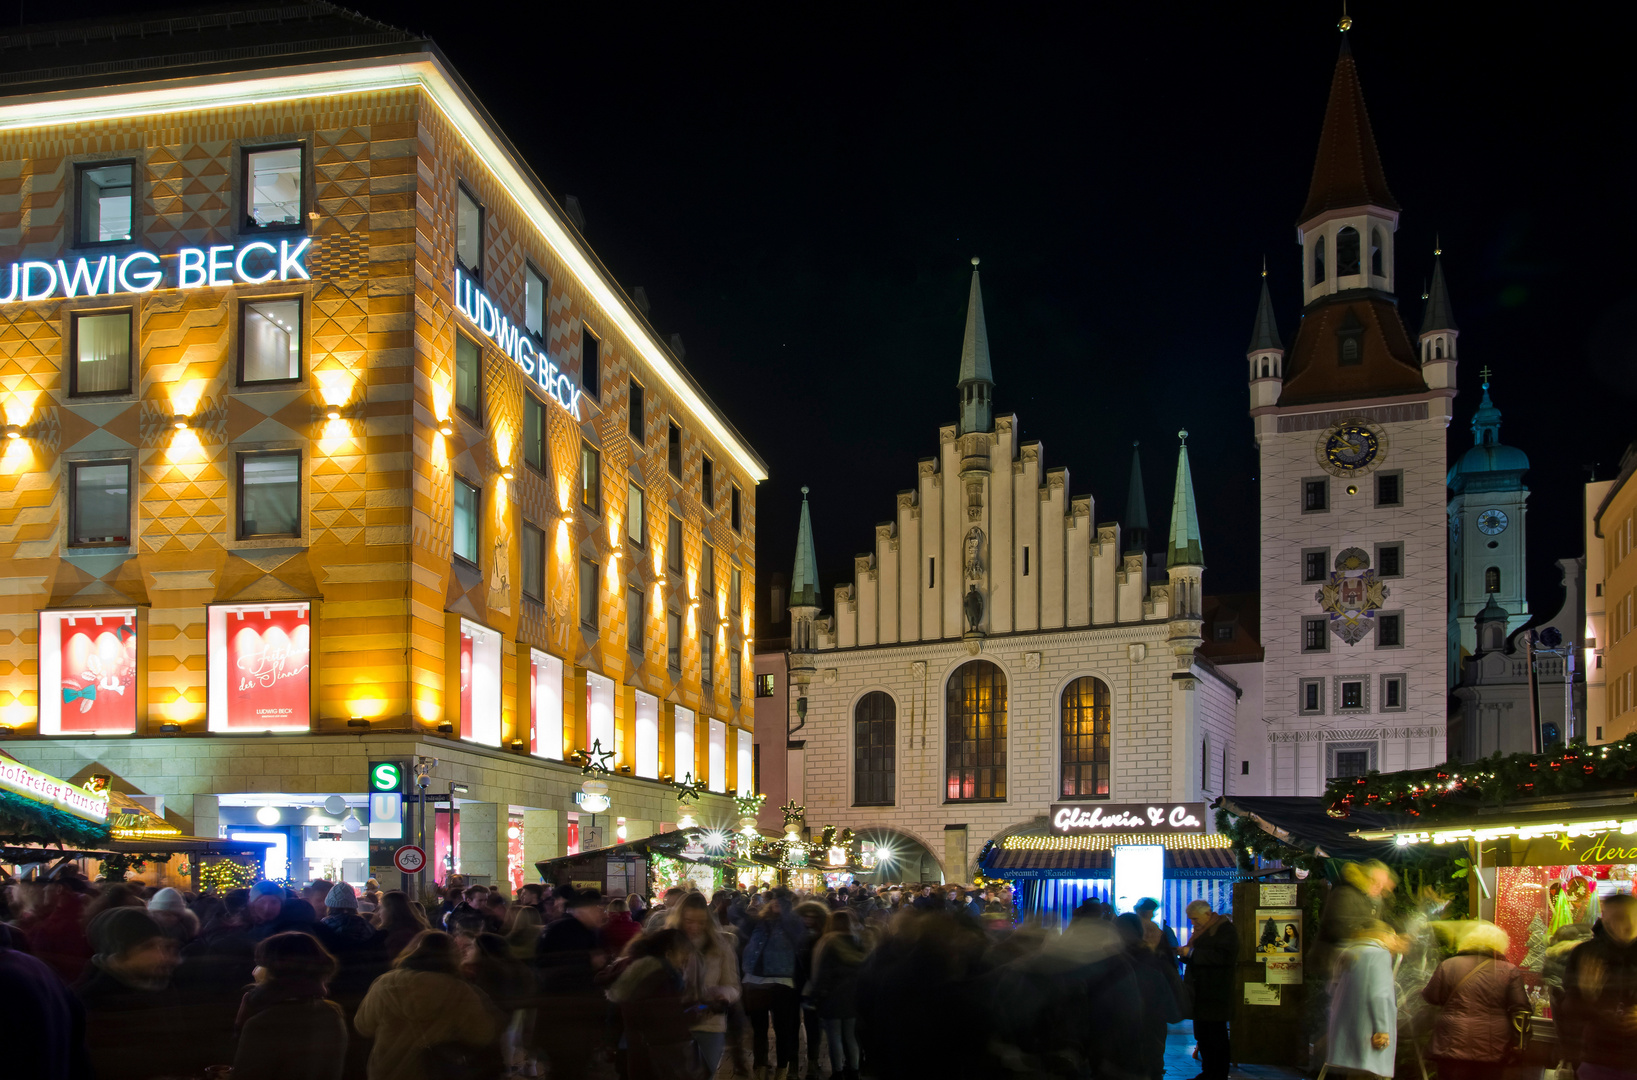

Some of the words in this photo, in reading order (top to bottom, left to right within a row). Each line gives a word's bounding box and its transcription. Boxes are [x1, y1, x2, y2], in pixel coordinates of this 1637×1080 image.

[178, 237, 313, 290] BECK
[455, 268, 535, 375] LUDWIG
[538, 352, 582, 422] BECK
[239, 676, 256, 691] der
[254, 660, 309, 688] Sinne
[375, 766, 397, 789] S
[63, 785, 109, 818] Punsch
[375, 796, 396, 820] U
[1054, 807, 1145, 832] Glühwein
[1146, 806, 1165, 827] &
[1168, 806, 1201, 828] Co.
[1580, 833, 1637, 862] Herz
[1043, 868, 1077, 877] Mandeln
[1173, 868, 1239, 877] Kräuterbonbons
